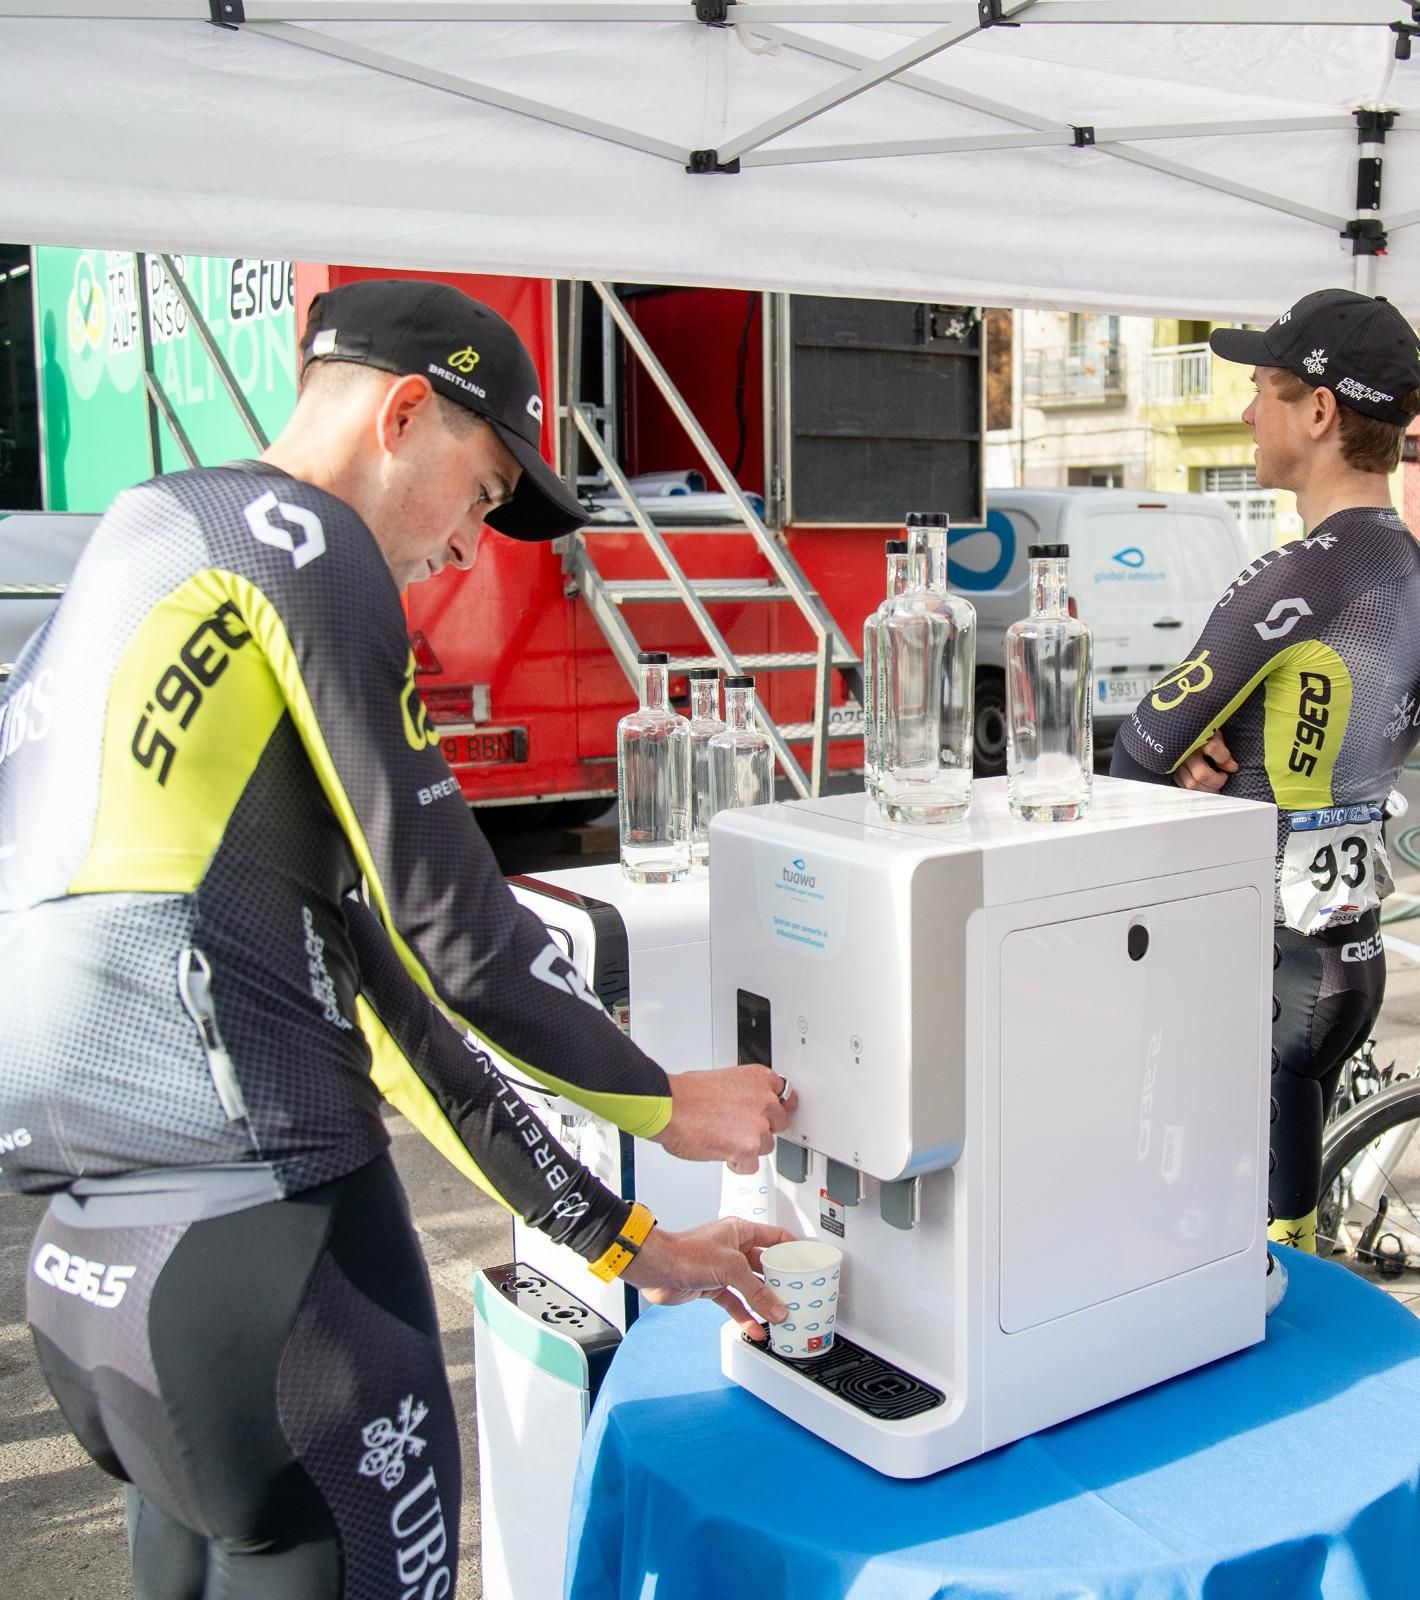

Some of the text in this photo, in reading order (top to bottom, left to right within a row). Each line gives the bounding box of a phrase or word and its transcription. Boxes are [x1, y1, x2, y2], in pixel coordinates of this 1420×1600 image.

[427, 363, 487, 399] BREITLING
[1335, 384, 1363, 401] TEAM
[1340, 381, 1381, 403] CYCLING
[1371, 390, 1394, 402] PRO
[131, 599, 253, 788] Q36.5
[1110, 681, 1138, 697] 5931
[1288, 671, 1332, 778] Q36.5
[782, 867, 816, 888] tuawa
[1309, 836, 1368, 892] 93
[1341, 930, 1382, 962] Q36.5
[390, 1465, 451, 1600] UBS
